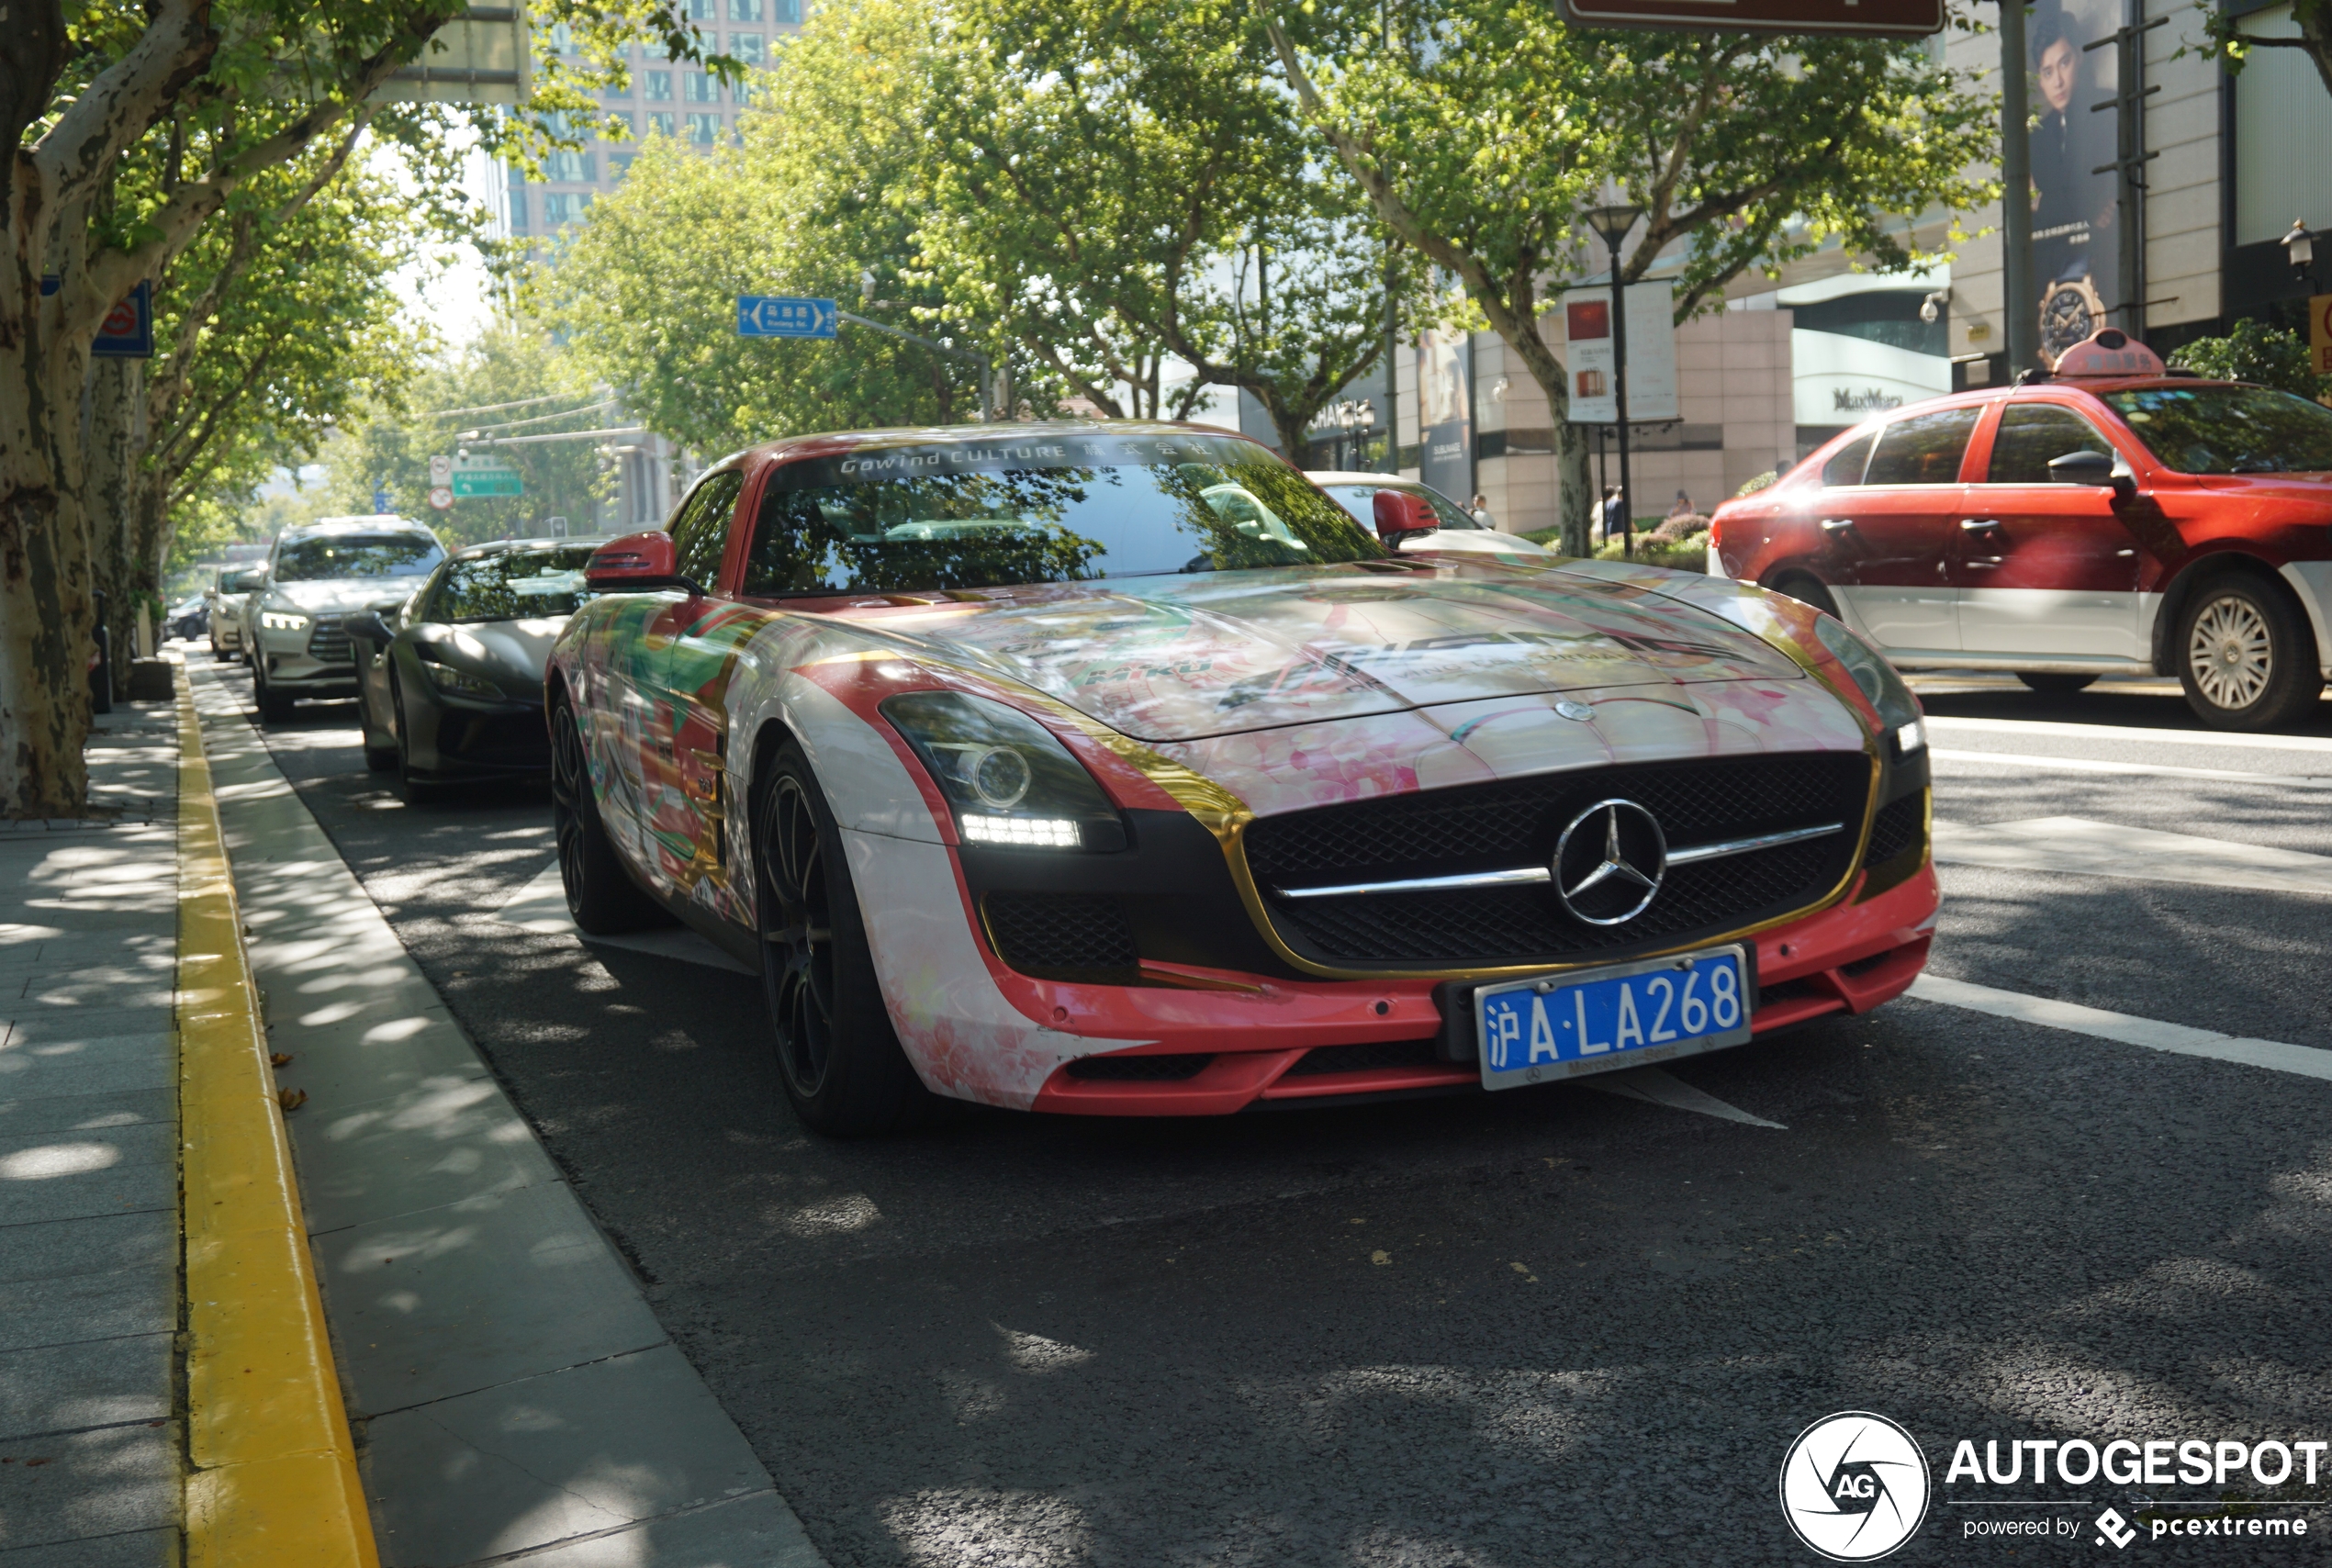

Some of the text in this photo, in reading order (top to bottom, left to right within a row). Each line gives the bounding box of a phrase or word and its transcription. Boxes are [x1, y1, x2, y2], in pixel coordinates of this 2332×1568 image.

[767, 305, 807, 318] 马当路
[796, 319, 807, 328] Rd.
[1309, 399, 1361, 430] CHANL
[1083, 442, 1212, 456] 株式会社
[840, 445, 1066, 474] Gowind CULTURE
[1085, 663, 1212, 685] MIKU
